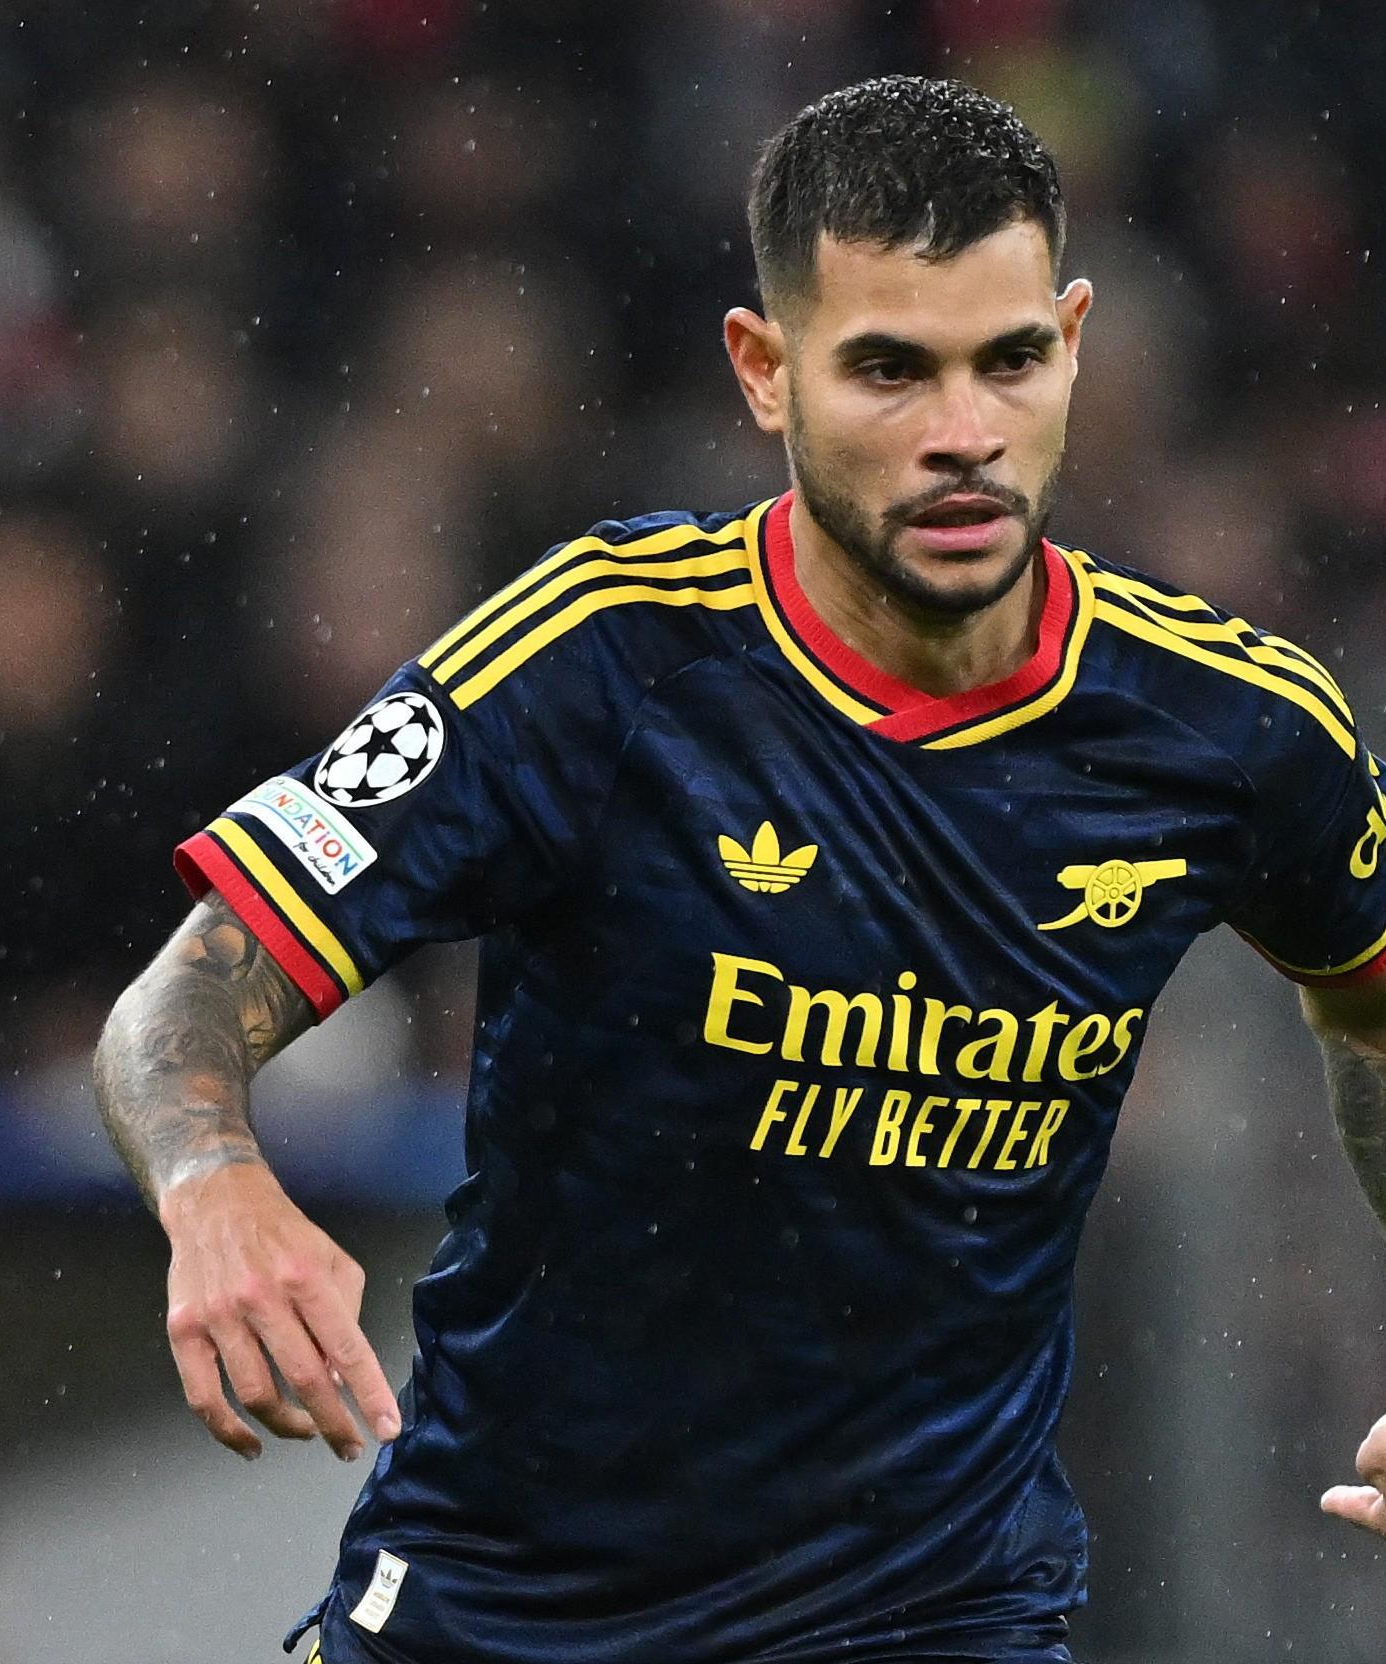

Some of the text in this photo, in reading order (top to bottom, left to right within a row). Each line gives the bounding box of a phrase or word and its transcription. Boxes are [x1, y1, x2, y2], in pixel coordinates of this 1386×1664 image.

[703, 951, 1144, 1083] Emirates
[749, 1079, 1071, 1171] FLY BETTER
